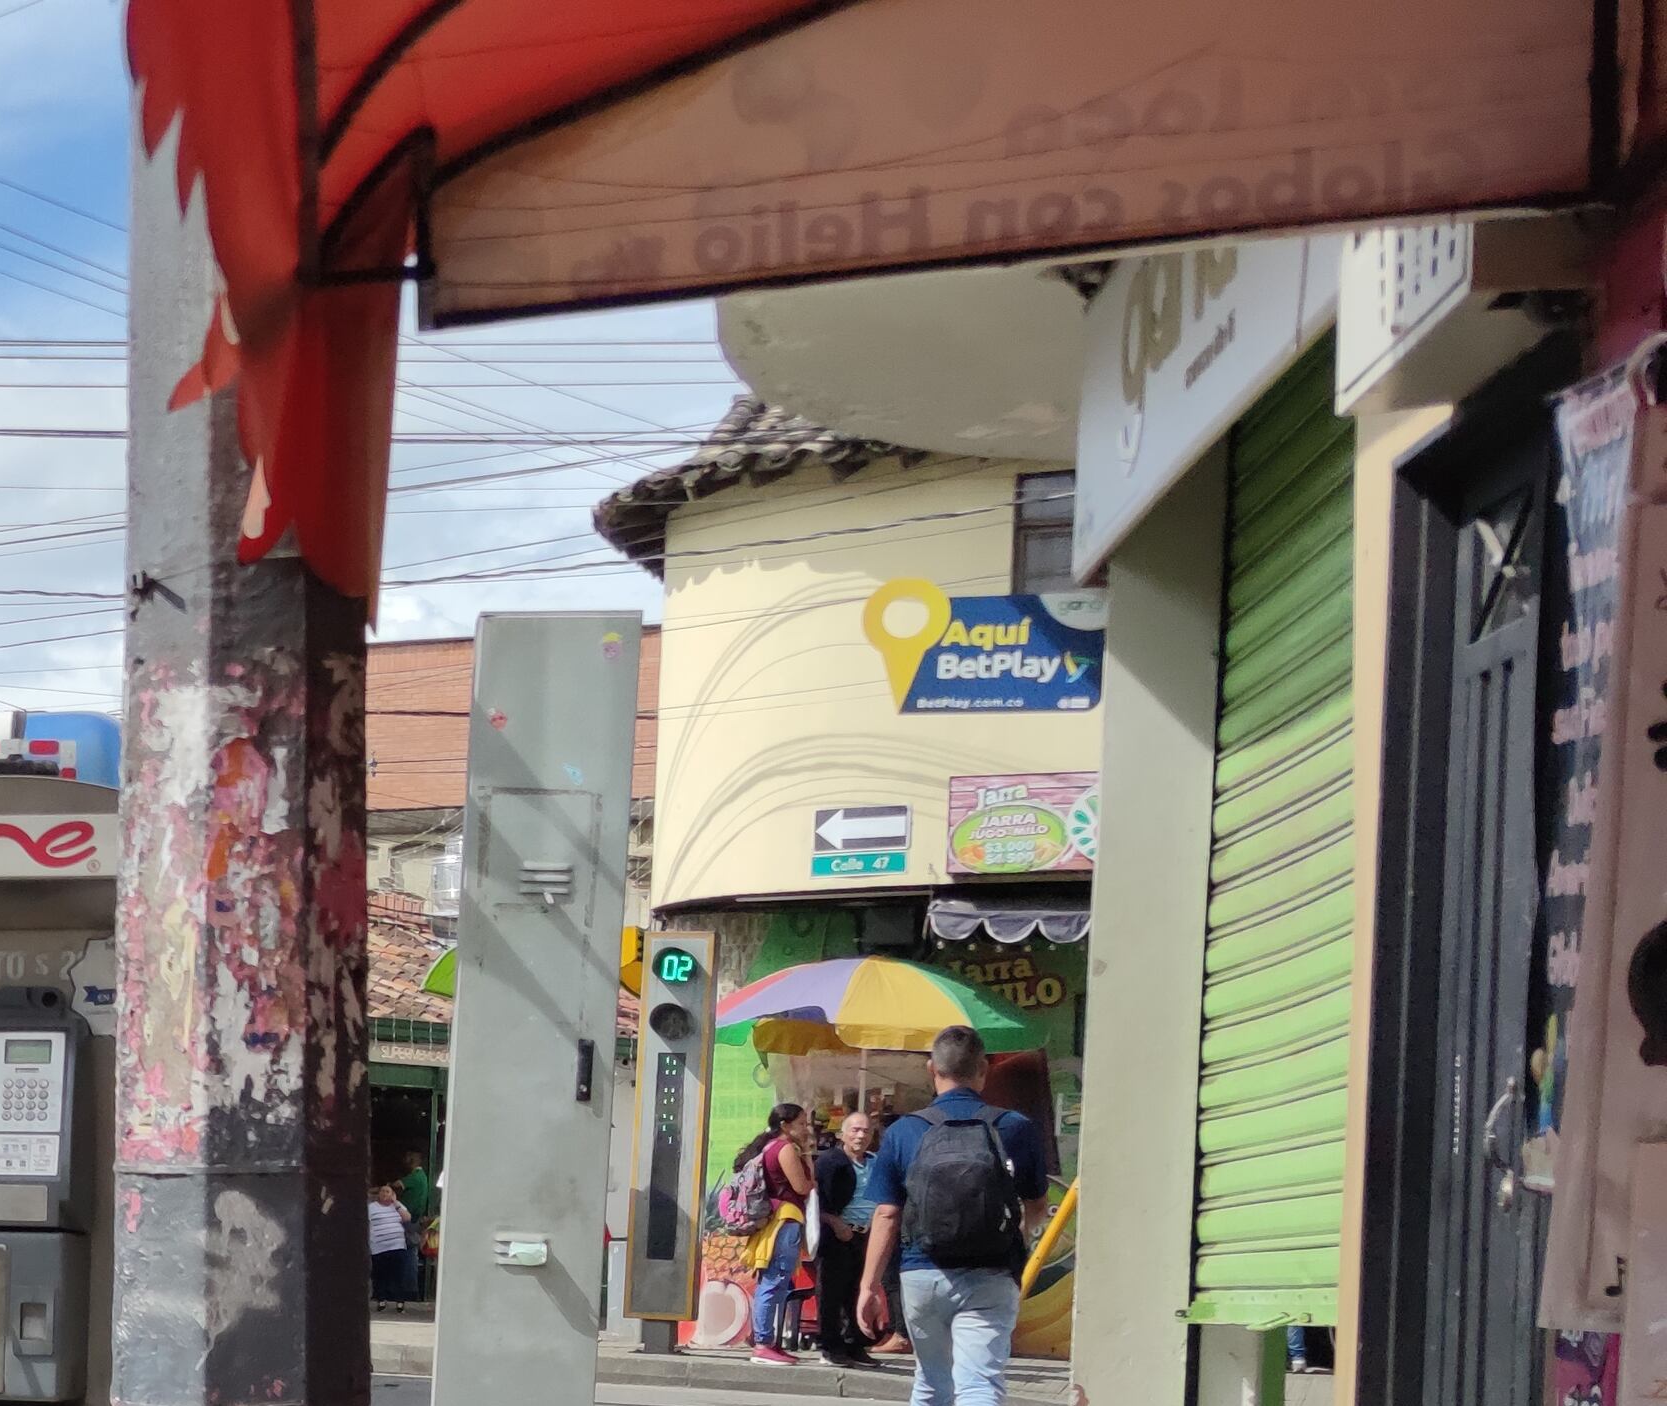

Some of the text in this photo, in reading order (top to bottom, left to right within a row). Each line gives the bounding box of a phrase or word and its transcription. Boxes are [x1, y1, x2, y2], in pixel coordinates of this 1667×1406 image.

[940, 616, 1033, 651] Aquí
[936, 651, 1061, 683] BetPlay
[916, 697, 1024, 708] BetPlay.com.co
[976, 784, 1028, 810] Jarra
[979, 812, 1037, 829] JARRA
[830, 856, 891, 873] Calle 47
[662, 955, 692, 982] 02
